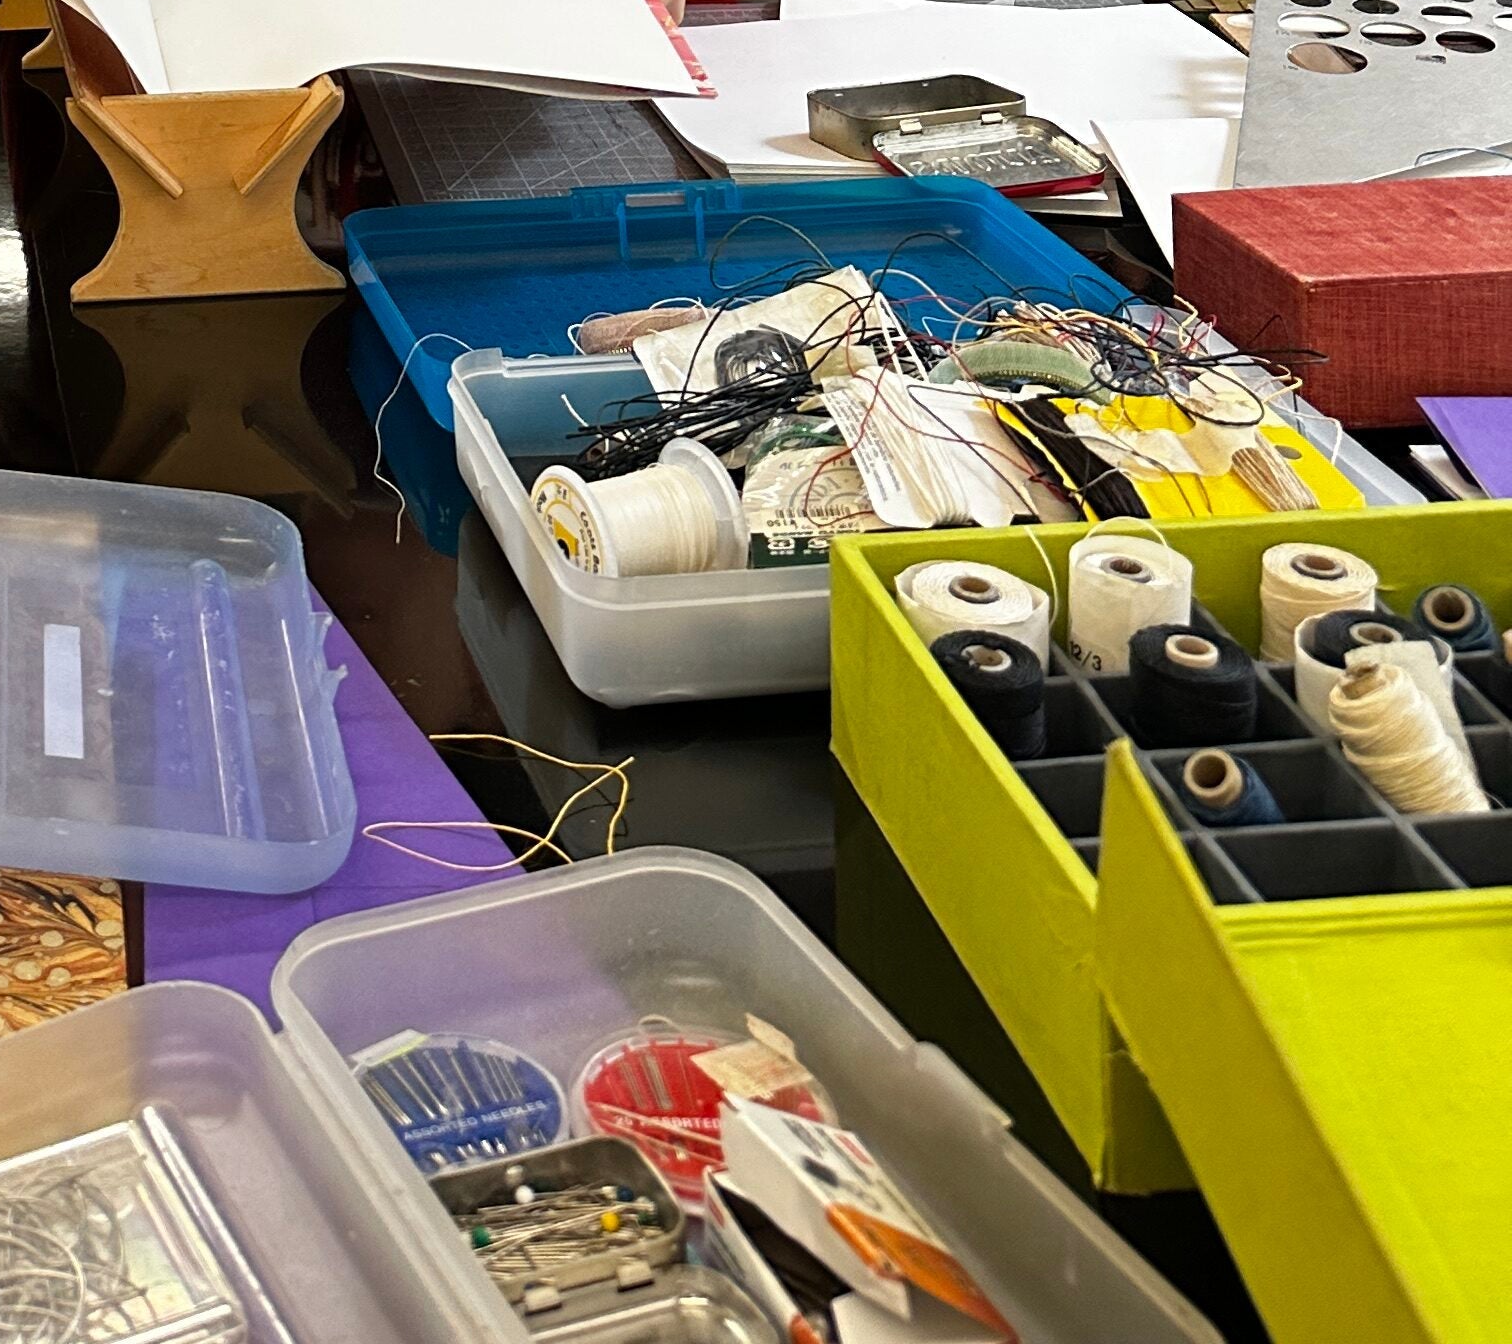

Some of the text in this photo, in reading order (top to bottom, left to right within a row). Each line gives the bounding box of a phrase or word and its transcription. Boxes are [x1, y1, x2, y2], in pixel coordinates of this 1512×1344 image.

[1069, 640, 1102, 672] 12/3
[403, 1099, 548, 1141] ASSORTED NEEDLES
